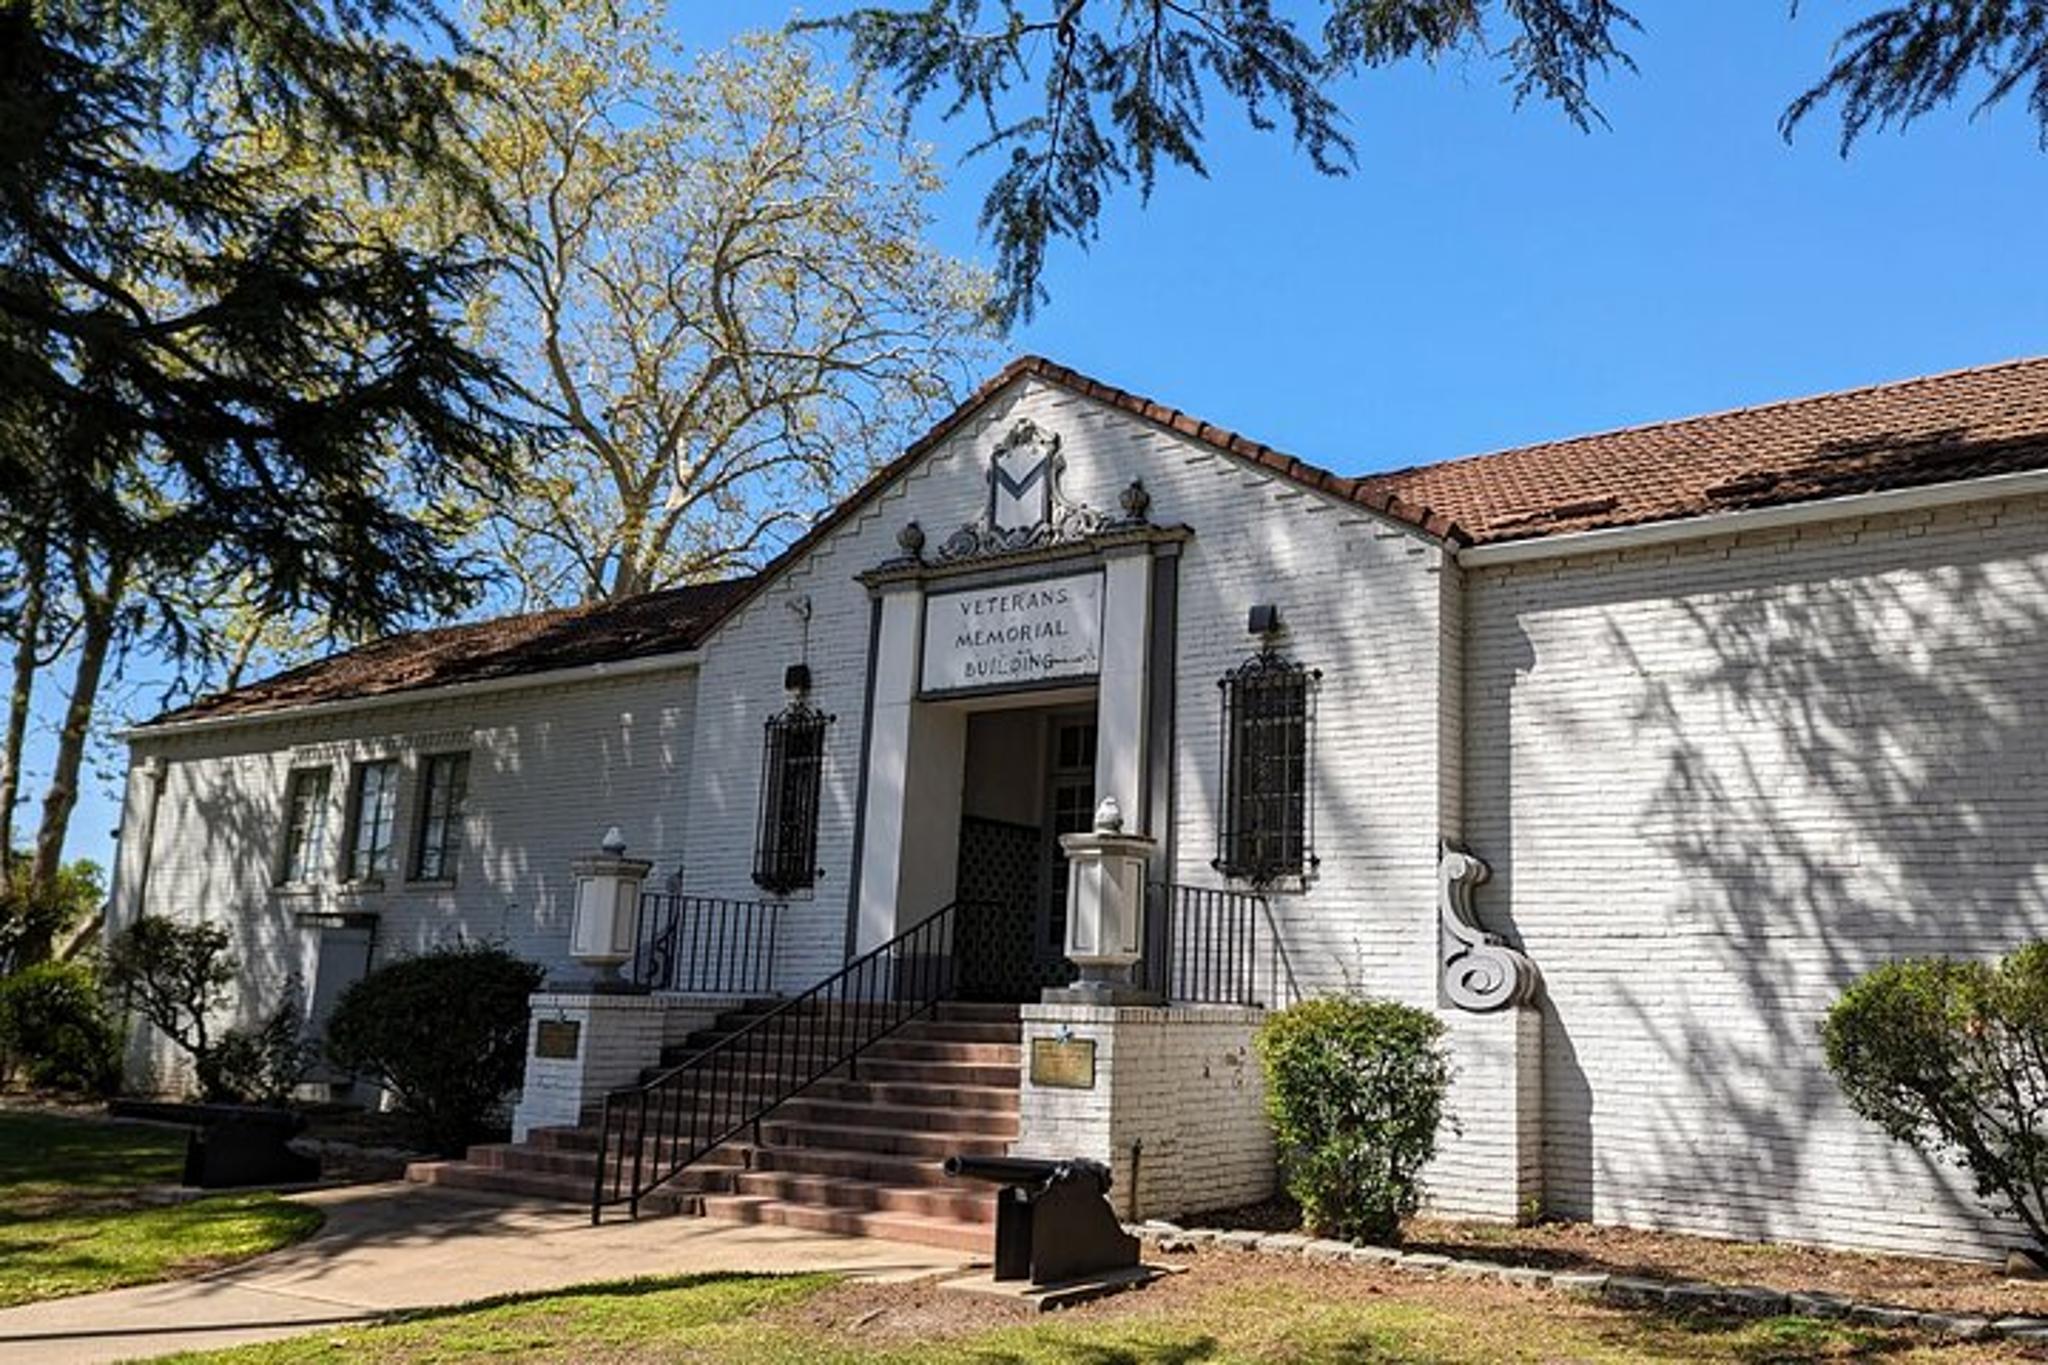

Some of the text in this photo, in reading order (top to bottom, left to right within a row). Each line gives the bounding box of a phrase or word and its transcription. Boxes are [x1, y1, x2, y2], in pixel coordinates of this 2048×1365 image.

[960, 588, 1069, 616] VETERANS
[956, 620, 1069, 648] MEMORIAL
[964, 653, 1054, 678] BUILDING
